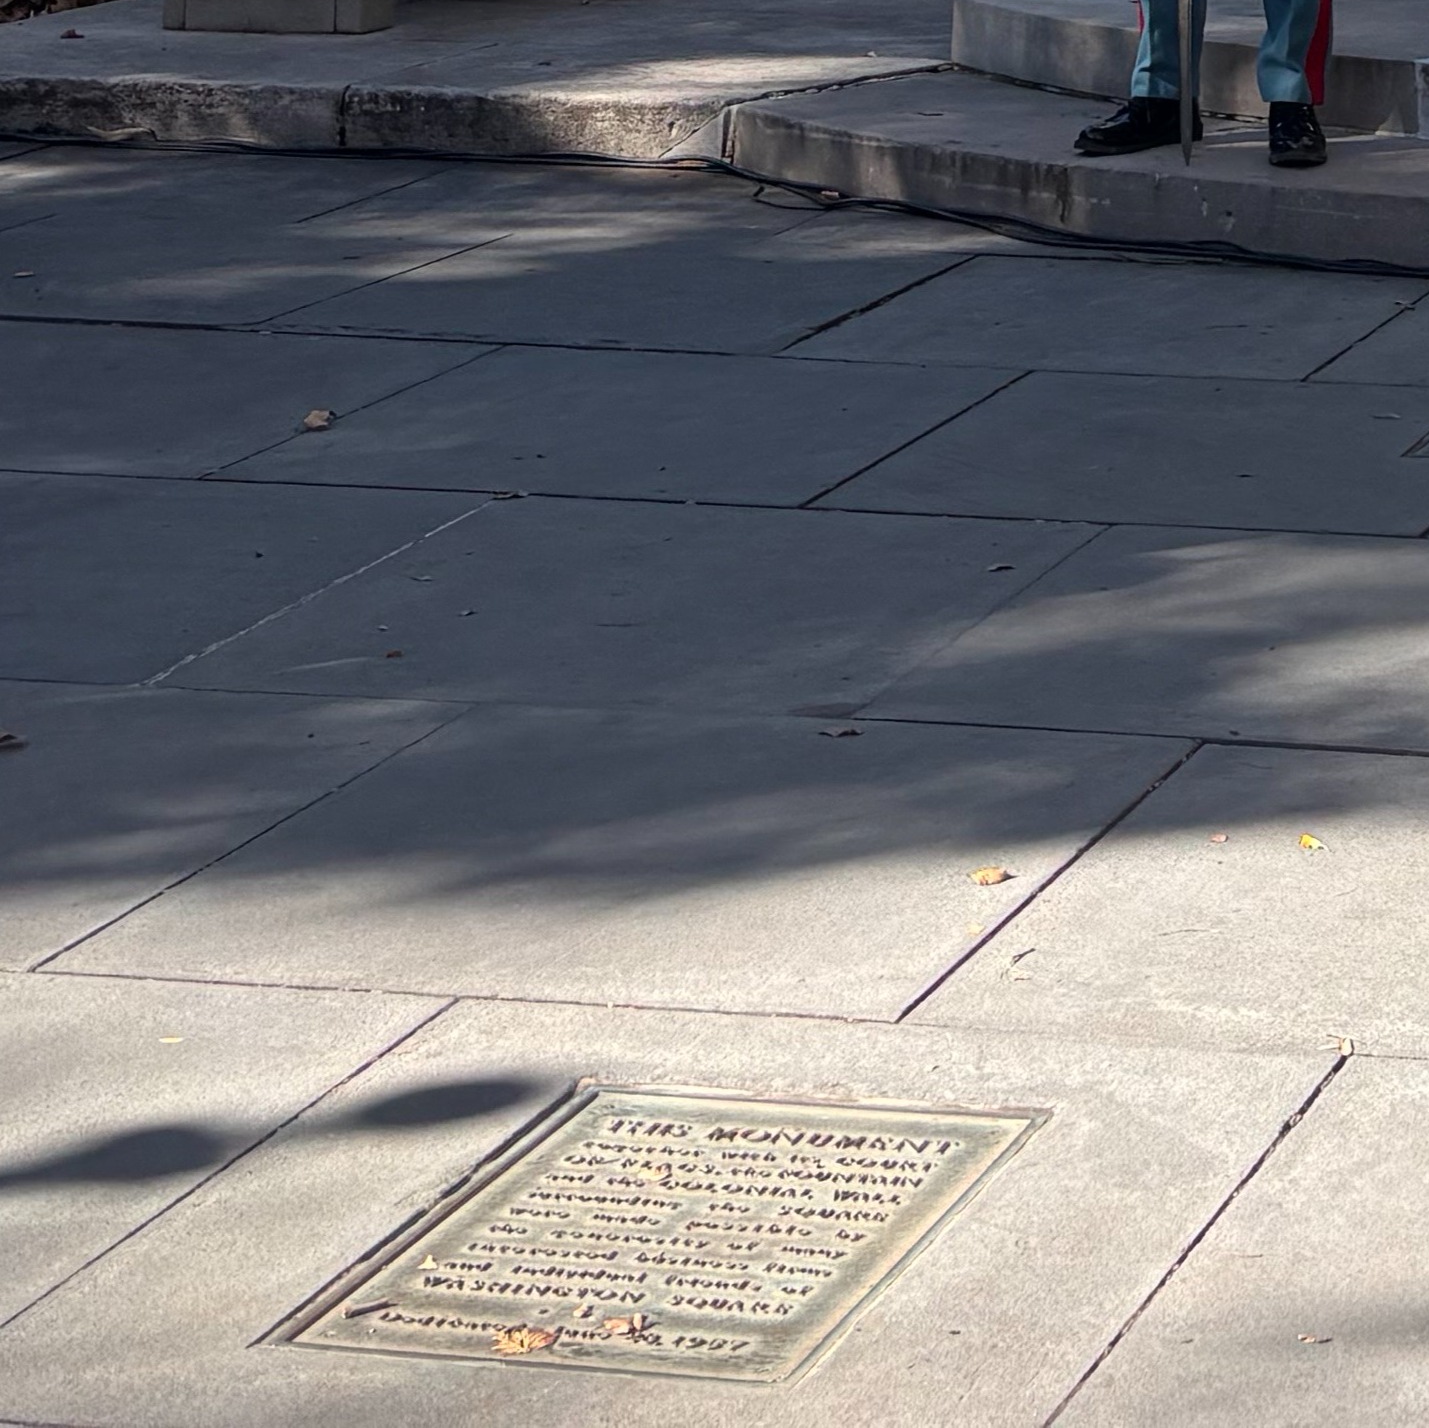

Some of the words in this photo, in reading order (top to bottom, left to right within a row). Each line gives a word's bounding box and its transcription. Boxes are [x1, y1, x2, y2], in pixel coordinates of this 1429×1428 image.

[610, 1120, 692, 1137] THIS
[707, 1128, 959, 1155] MONUMENT
[585, 1142, 700, 1158] together
[722, 1152, 777, 1162] with
[836, 1157, 936, 1172] COURT
[546, 1174, 595, 1184] and
[607, 1176, 645, 1188] the
[659, 1176, 813, 1200] COLONIAL
[833, 1190, 901, 1206] WALL
[778, 1170, 923, 1188] FOUNTAIN
[529, 1187, 679, 1210] surrounding
[709, 1202, 750, 1213] the
[779, 1205, 889, 1223] SQUARE
[490, 1223, 528, 1235] the
[551, 1230, 709, 1249] generosity
[728, 1242, 758, 1251] of
[781, 1246, 845, 1260] many
[510, 1208, 570, 1219] were
[593, 1214, 660, 1226] made
[685, 1221, 812, 1237] possible
[837, 1229, 865, 1242] by
[468, 1243, 619, 1261] interested
[635, 1251, 749, 1270] business
[765, 1263, 832, 1277] firms
[423, 1276, 646, 1304] WASHINGTON
[672, 1295, 793, 1315] SQUARE
[444, 1262, 493, 1272] and
[512, 1265, 648, 1284] individual
[781, 1286, 813, 1296] of
